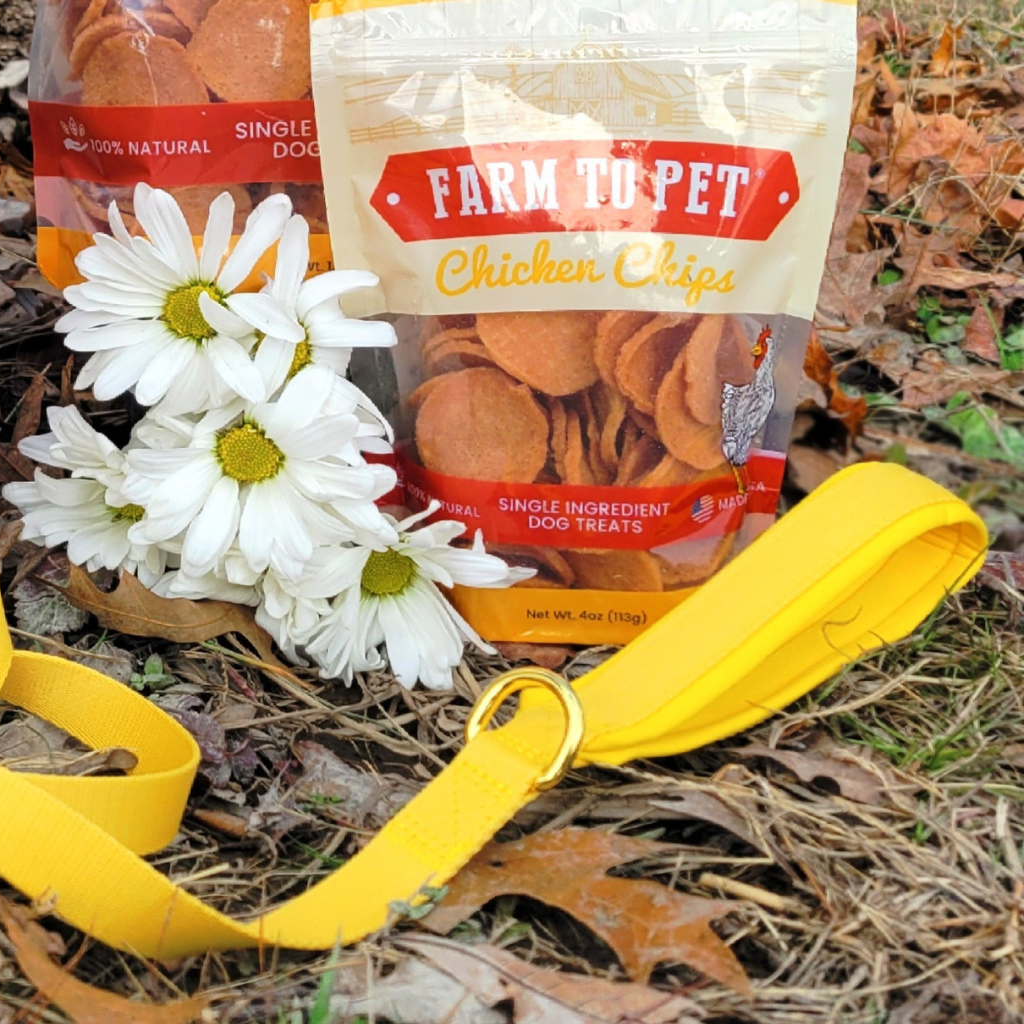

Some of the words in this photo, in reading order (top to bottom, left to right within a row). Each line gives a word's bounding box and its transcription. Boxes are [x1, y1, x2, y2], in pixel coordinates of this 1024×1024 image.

[235, 120, 312, 139] SINGLE
[90, 138, 124, 155] 100%
[128, 139, 211, 156] NATURAL
[426, 159, 560, 219] FARM
[577, 157, 637, 211] TO
[435, 239, 605, 297] Chicken
[613, 240, 736, 307] Chips
[498, 497, 560, 514] SINGLE
[565, 501, 671, 518] INGREDIENT
[528, 515, 570, 531] DOG
[576, 517, 643, 534] TREATS
[526, 609, 550, 619] Net
[553, 610, 575, 620] Wt.
[579, 610, 603, 621] 4oz
[607, 609, 647, 625] (113g)
